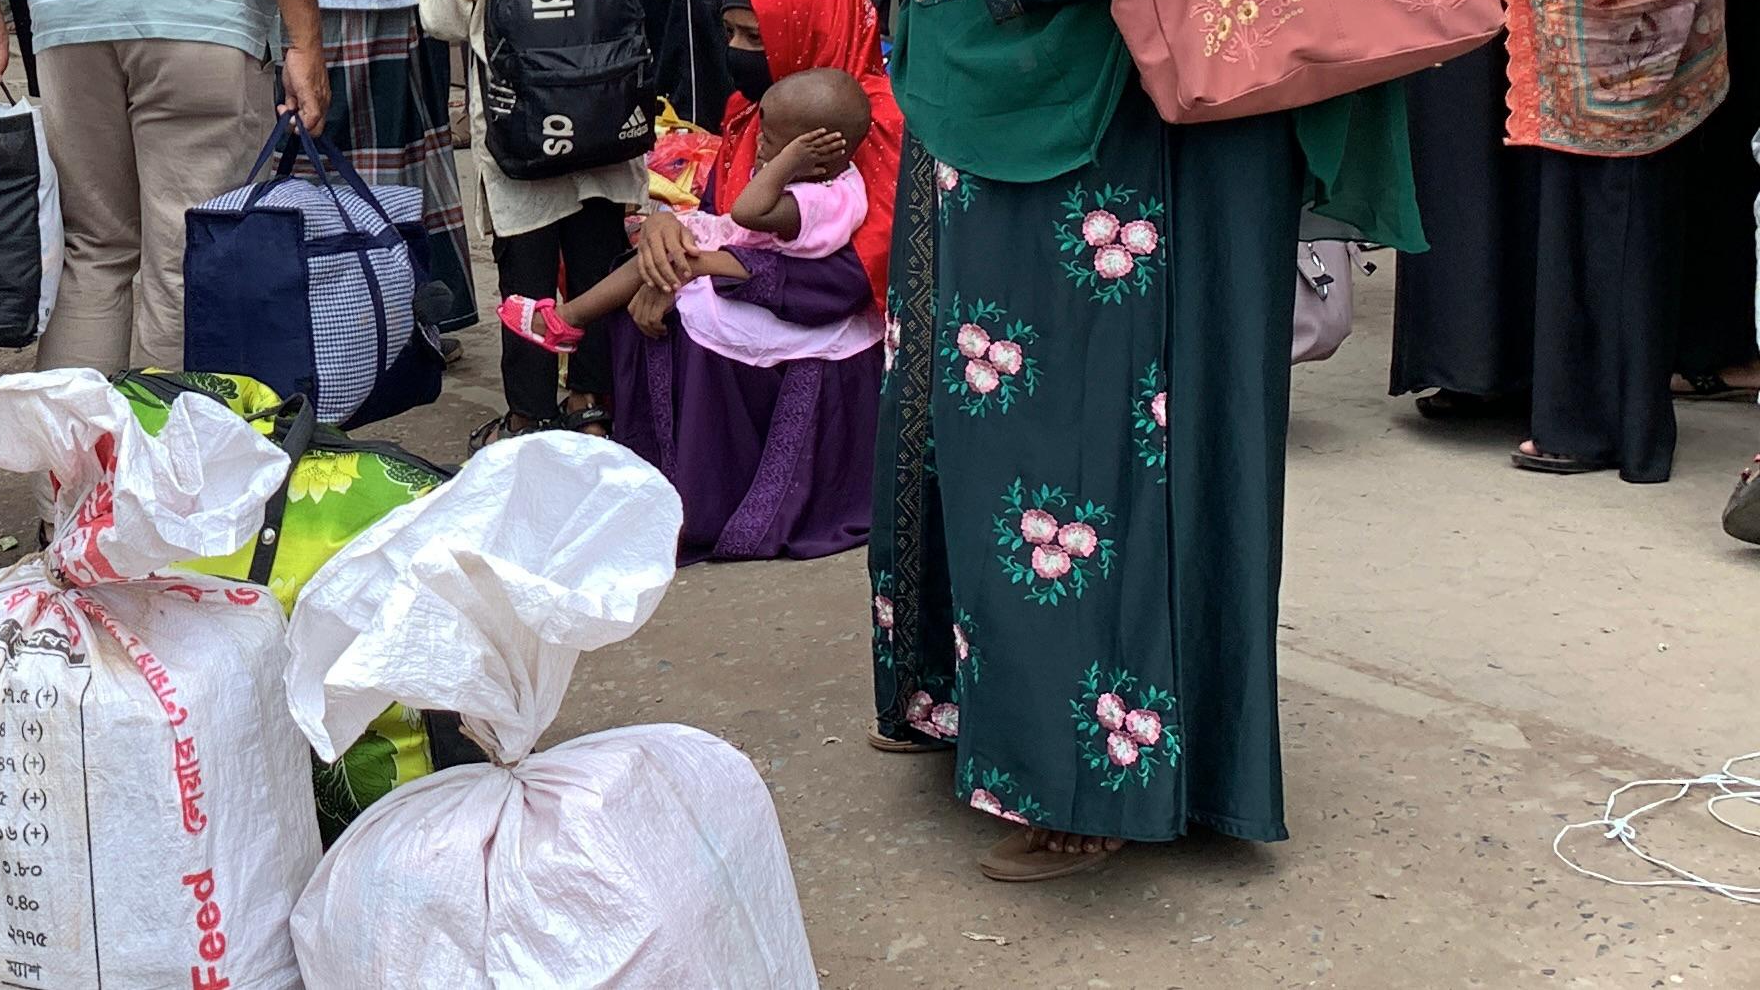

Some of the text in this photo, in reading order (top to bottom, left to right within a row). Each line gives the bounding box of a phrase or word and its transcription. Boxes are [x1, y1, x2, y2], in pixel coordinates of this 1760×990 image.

[618, 123, 649, 141] adidas
[21, 719, 44, 742] (+)
[22, 751, 46, 775] (+)
[22, 787, 48, 811] (+)
[23, 823, 49, 846] (+)
[181, 867, 232, 990] Feed
